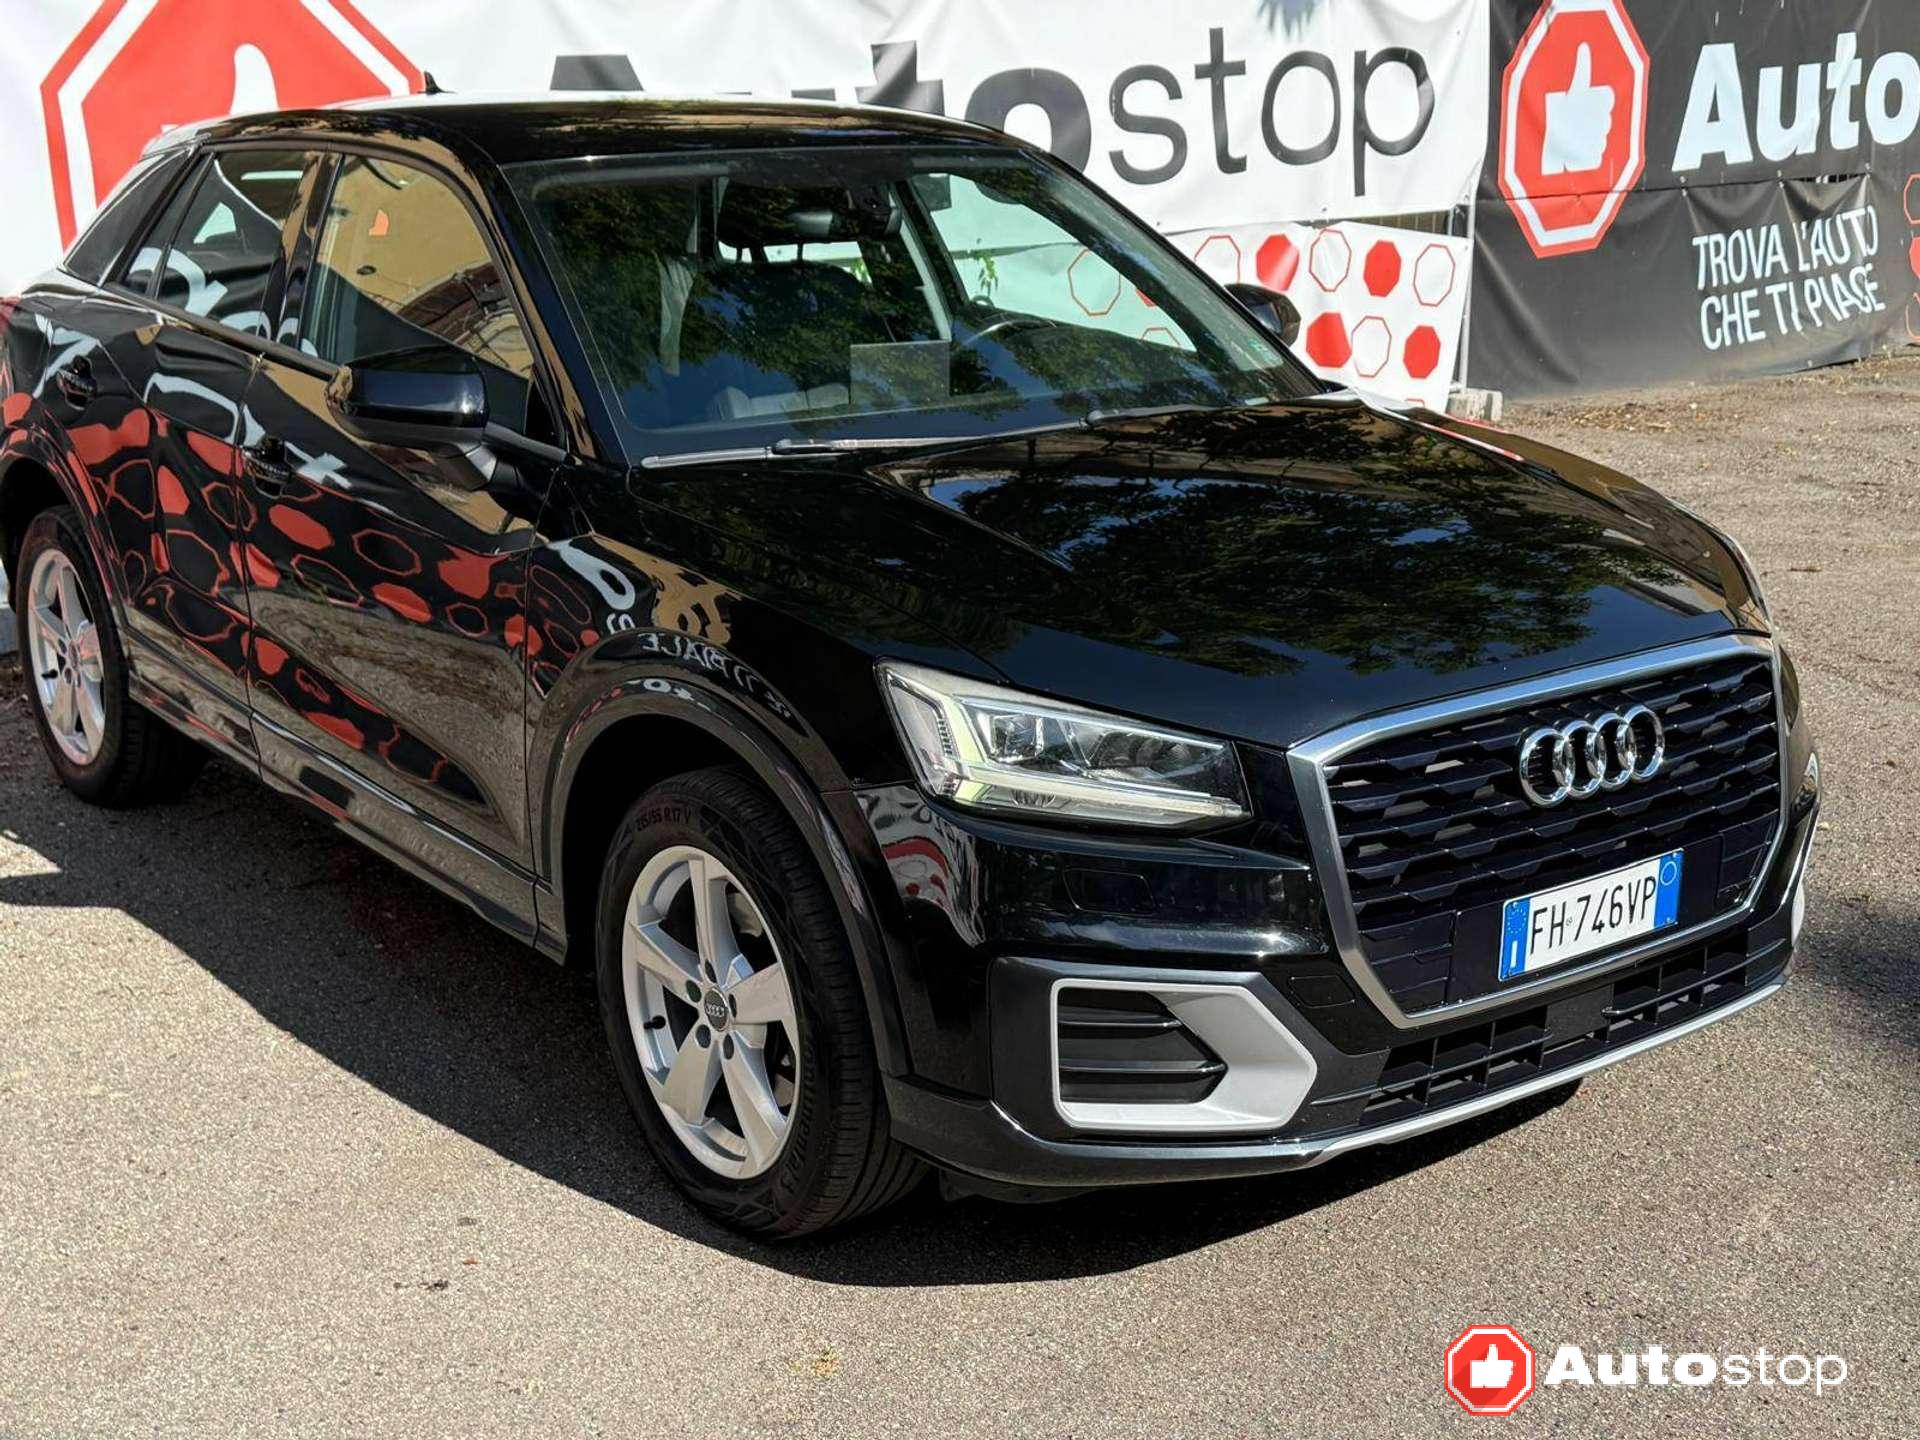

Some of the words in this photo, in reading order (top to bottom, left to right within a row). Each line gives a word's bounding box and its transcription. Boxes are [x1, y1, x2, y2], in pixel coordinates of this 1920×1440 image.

[1671, 32, 1920, 172] Auto
[1692, 223, 1789, 290] TROVA
[1700, 288, 1766, 351] CHE
[1765, 281, 1804, 335] TI
[1530, 901, 1567, 954] FH
[1574, 876, 1657, 941] 746VP
